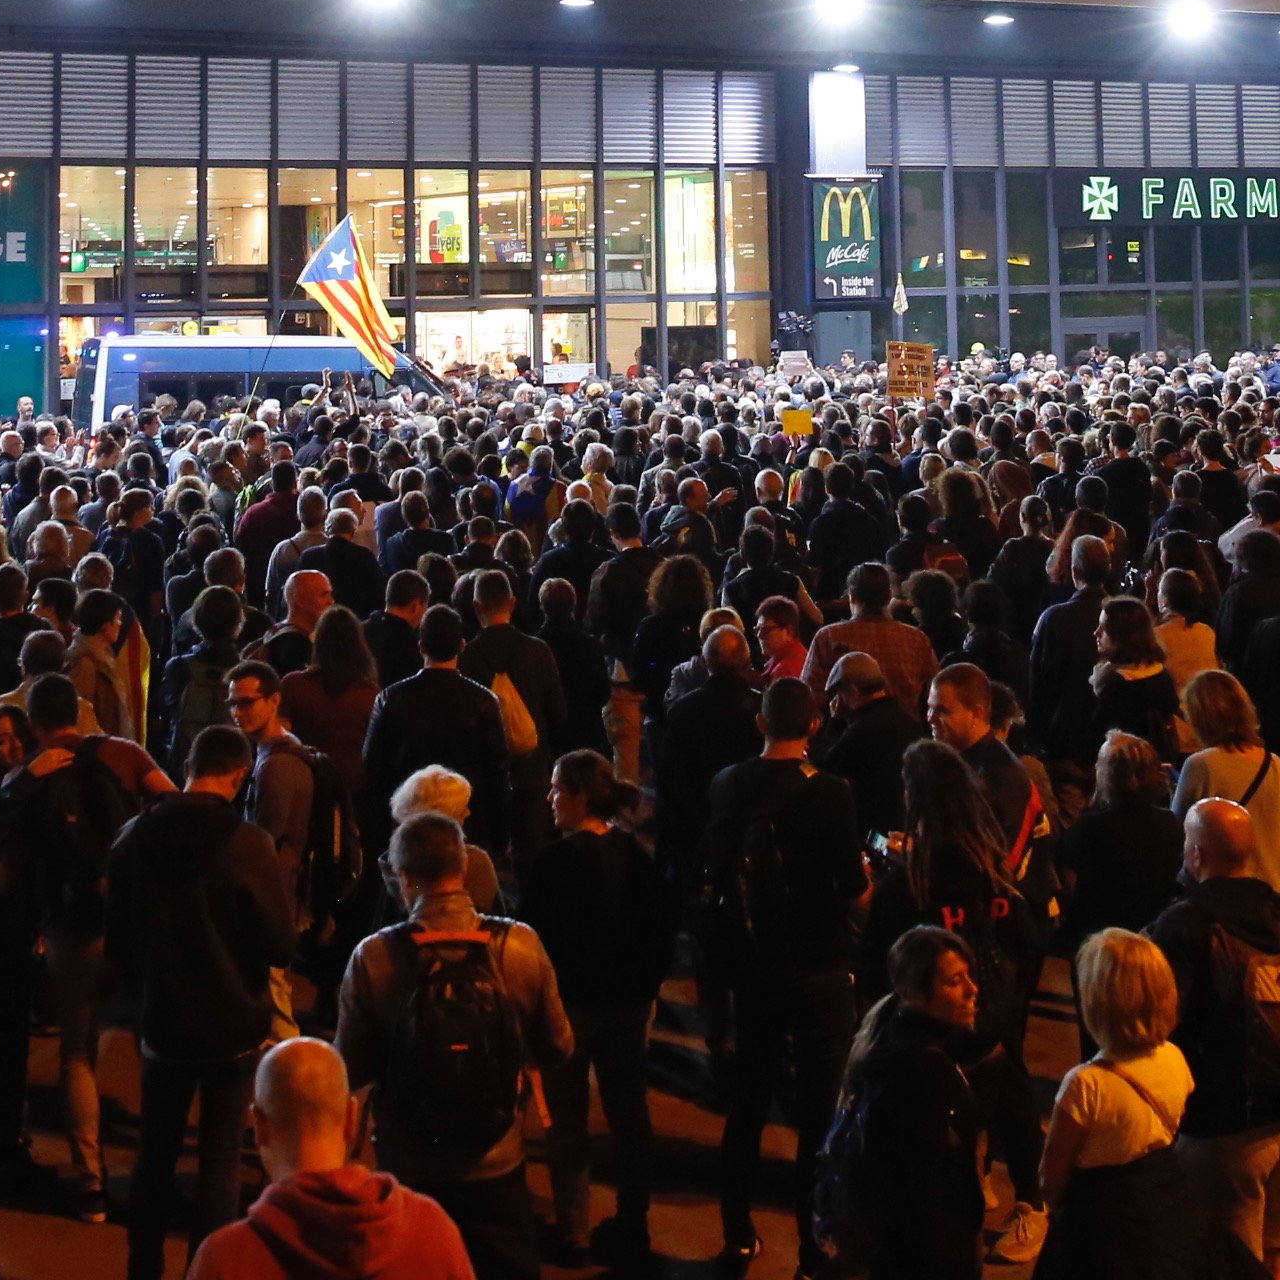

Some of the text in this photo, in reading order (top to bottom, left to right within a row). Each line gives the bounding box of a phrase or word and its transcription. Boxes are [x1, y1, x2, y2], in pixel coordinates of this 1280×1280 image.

[841, 276, 874, 287] Inside the
[841, 287, 867, 297] Station
